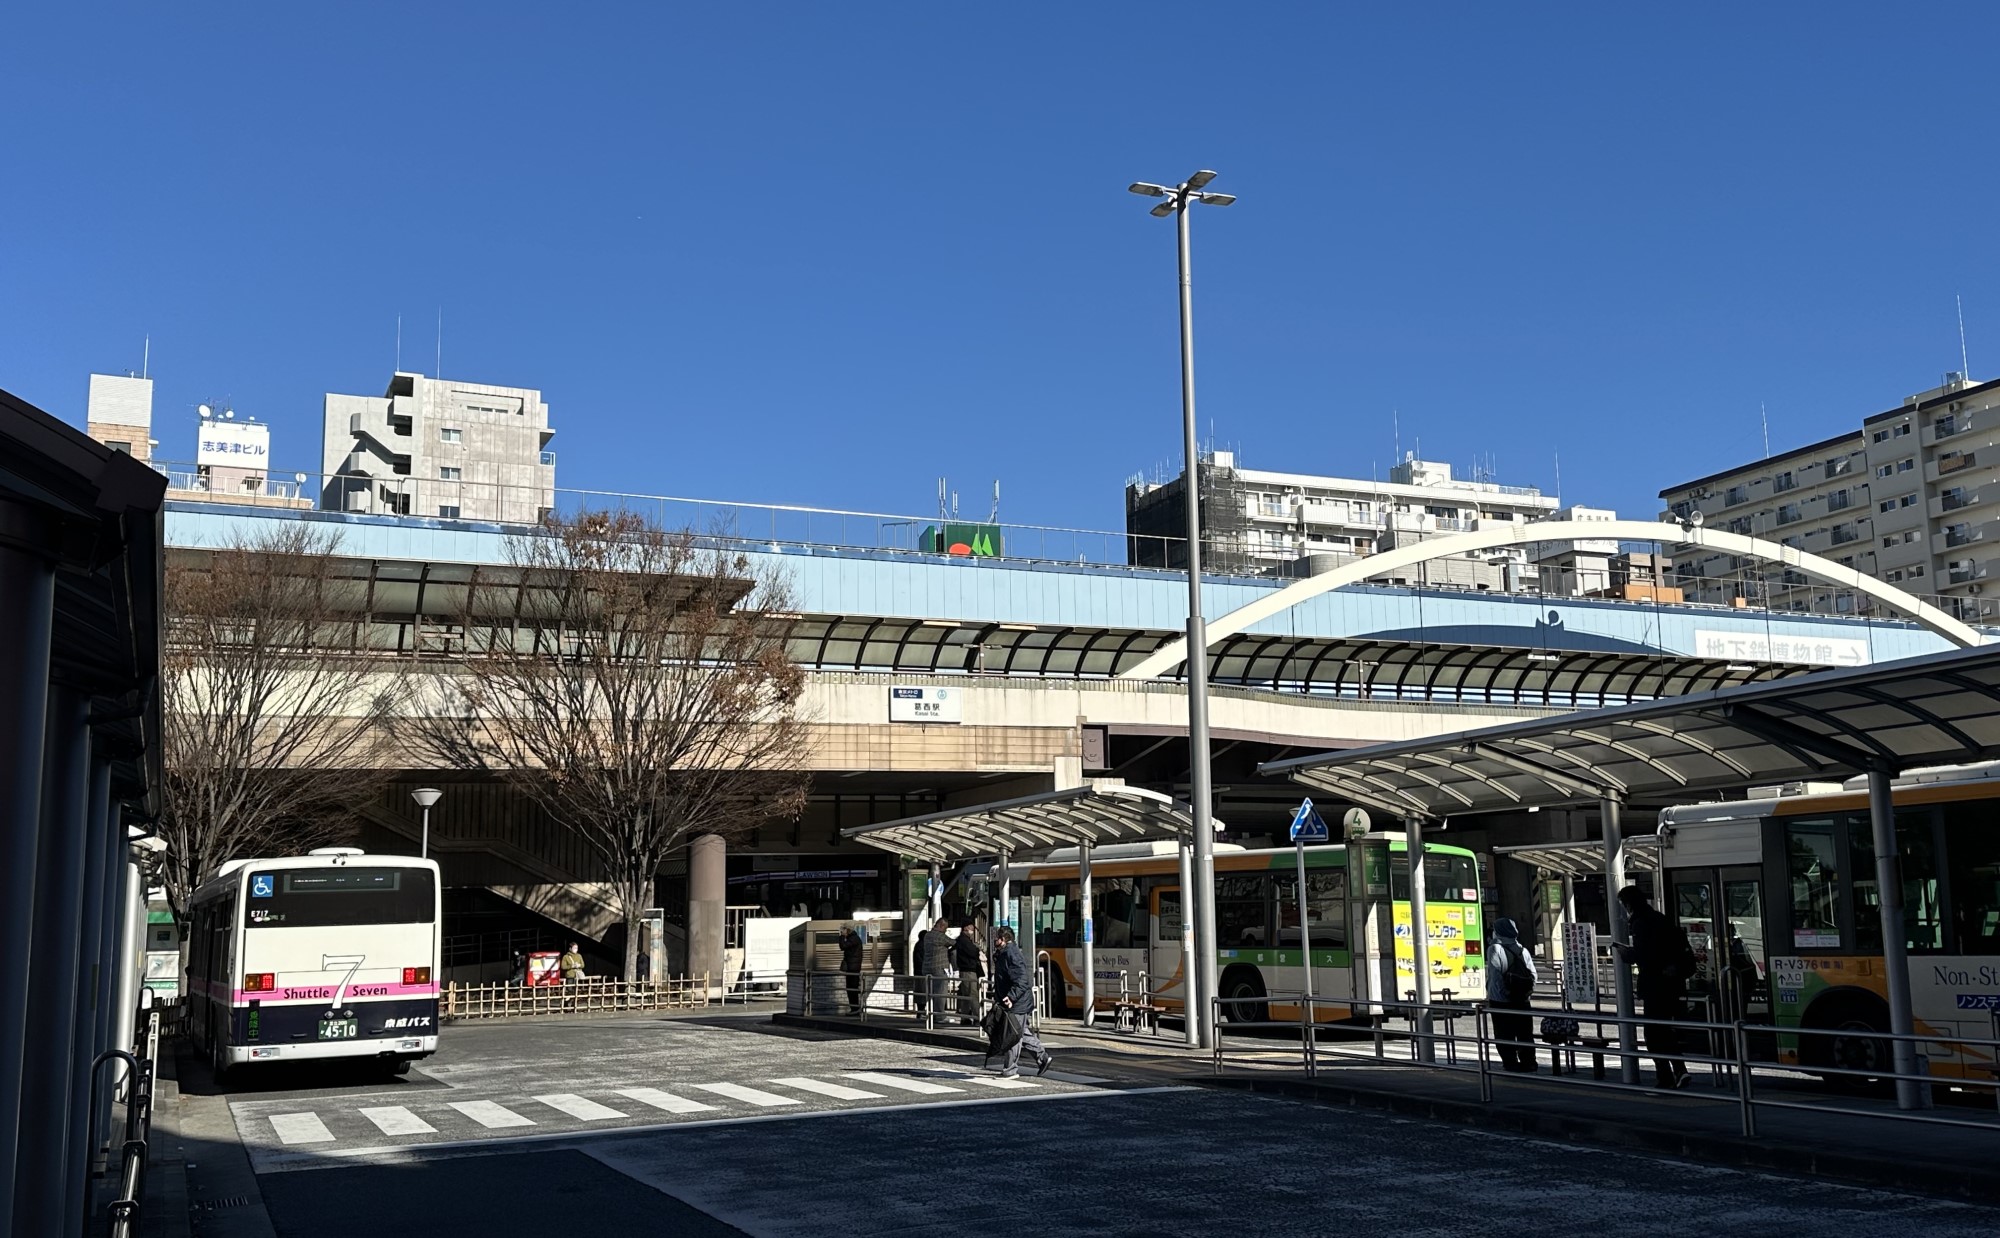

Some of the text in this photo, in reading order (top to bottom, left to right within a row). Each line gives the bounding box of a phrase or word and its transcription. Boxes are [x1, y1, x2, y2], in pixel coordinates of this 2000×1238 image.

[203, 441, 266, 455] 志美津ビル
[1706, 638, 1833, 662] 地下鉄博物館
[914, 703, 940, 711] 葛西駅
[1353, 811, 1362, 826] 4
[1372, 865, 1380, 882] 4
[251, 910, 269, 918] E717
[1774, 959, 1818, 970] R-V376
[1787, 973, 1802, 981] 入口
[284, 986, 388, 999] Shuttle Seven
[384, 1016, 431, 1029] 京成バス
